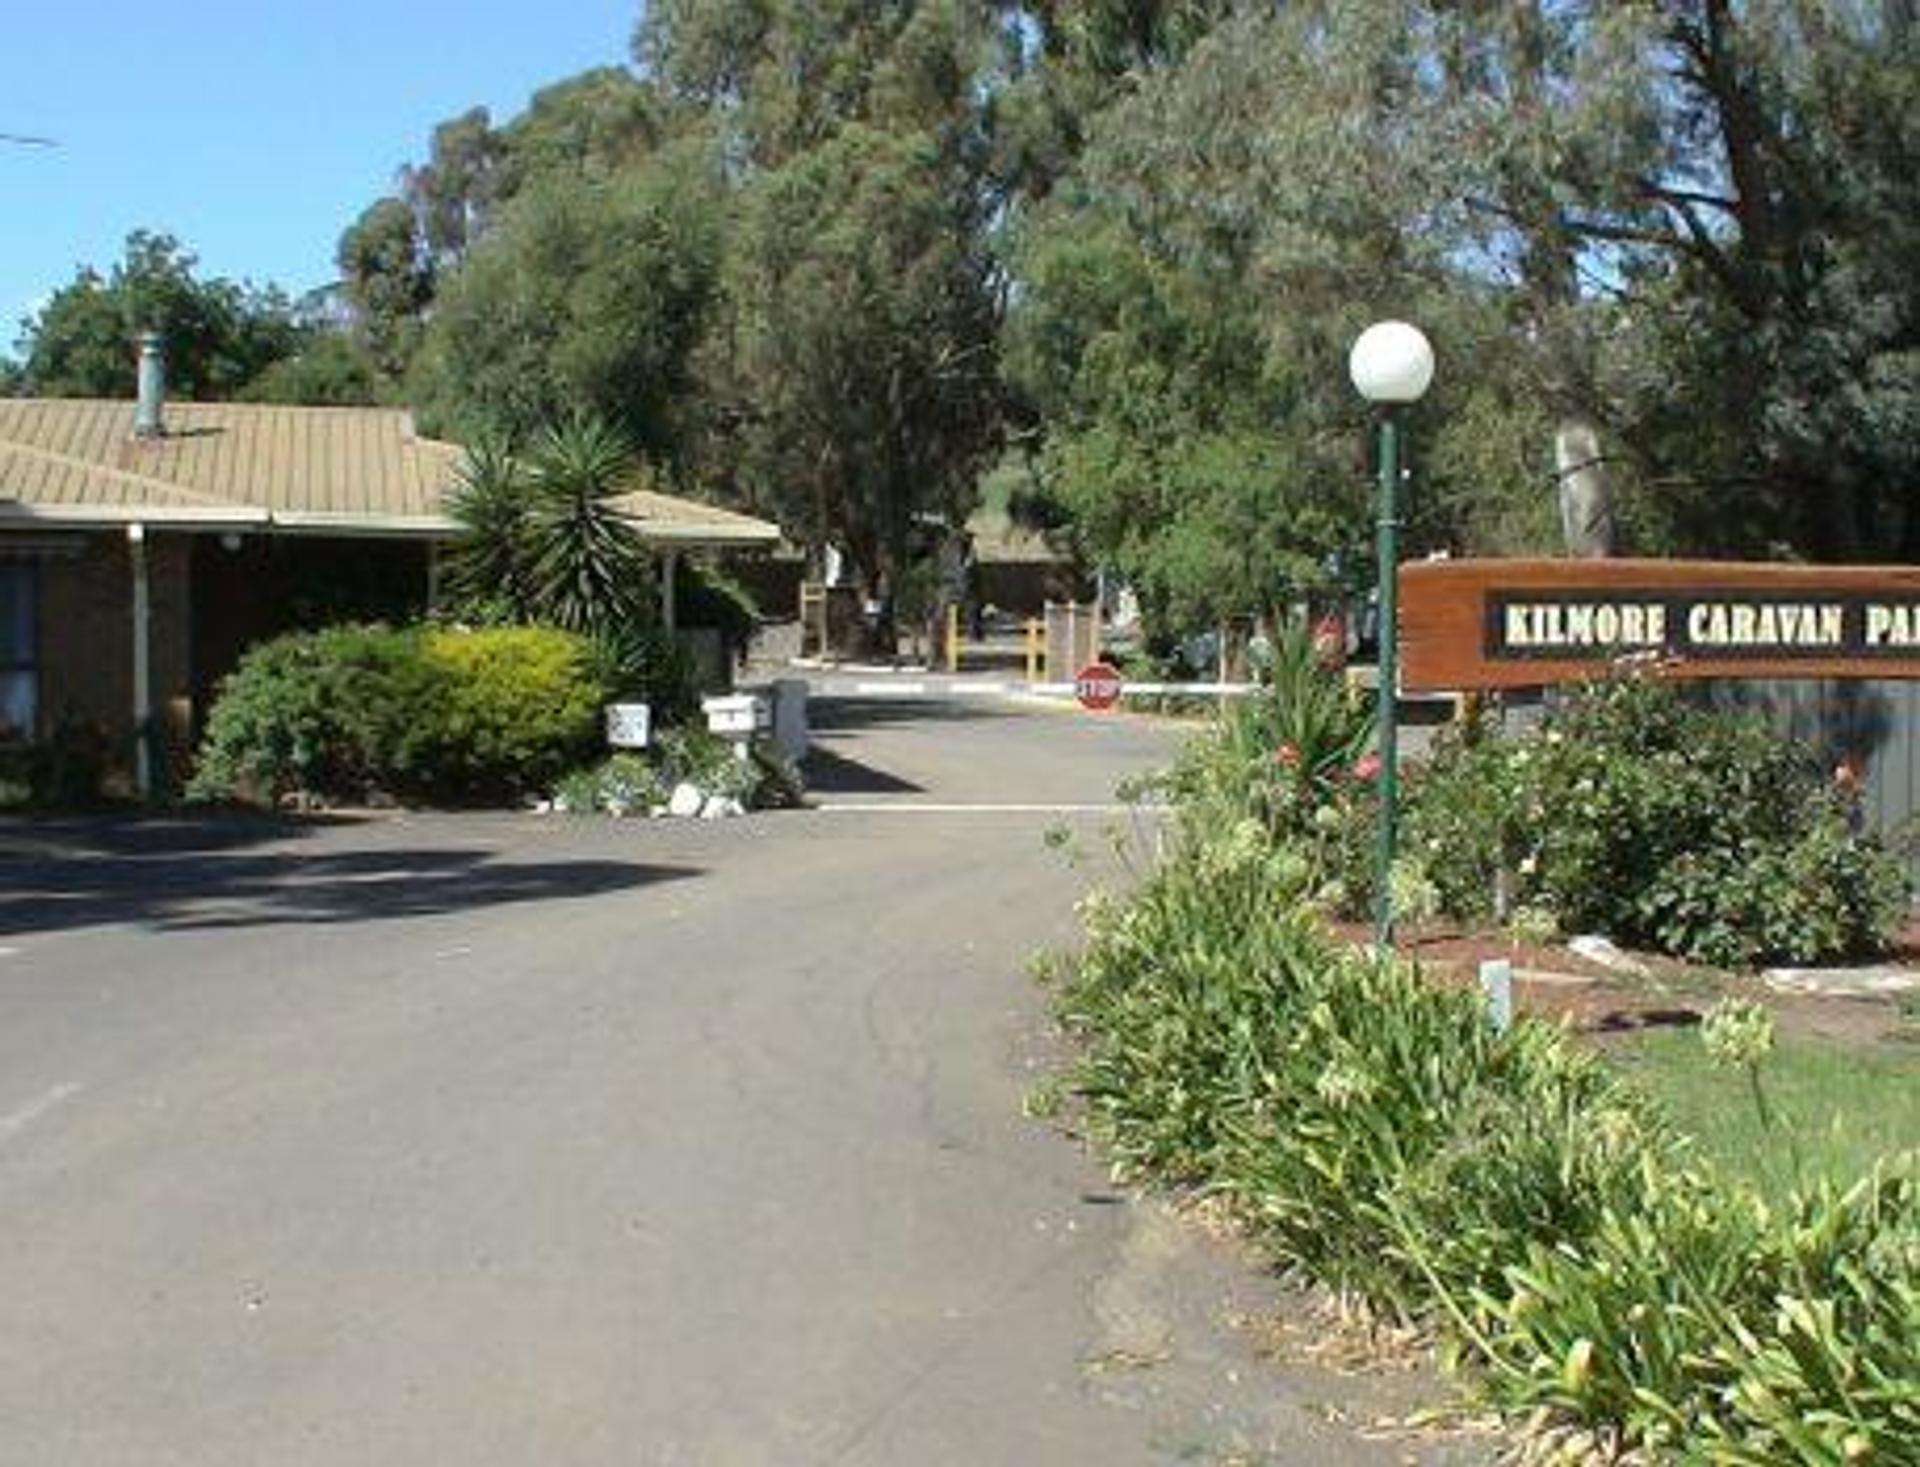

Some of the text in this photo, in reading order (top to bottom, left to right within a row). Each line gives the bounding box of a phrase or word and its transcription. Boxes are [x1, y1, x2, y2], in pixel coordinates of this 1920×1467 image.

[1506, 604, 1666, 644] KILMORE
[1689, 604, 1842, 644] CARAVAN
[1075, 679, 1118, 697] STOP
